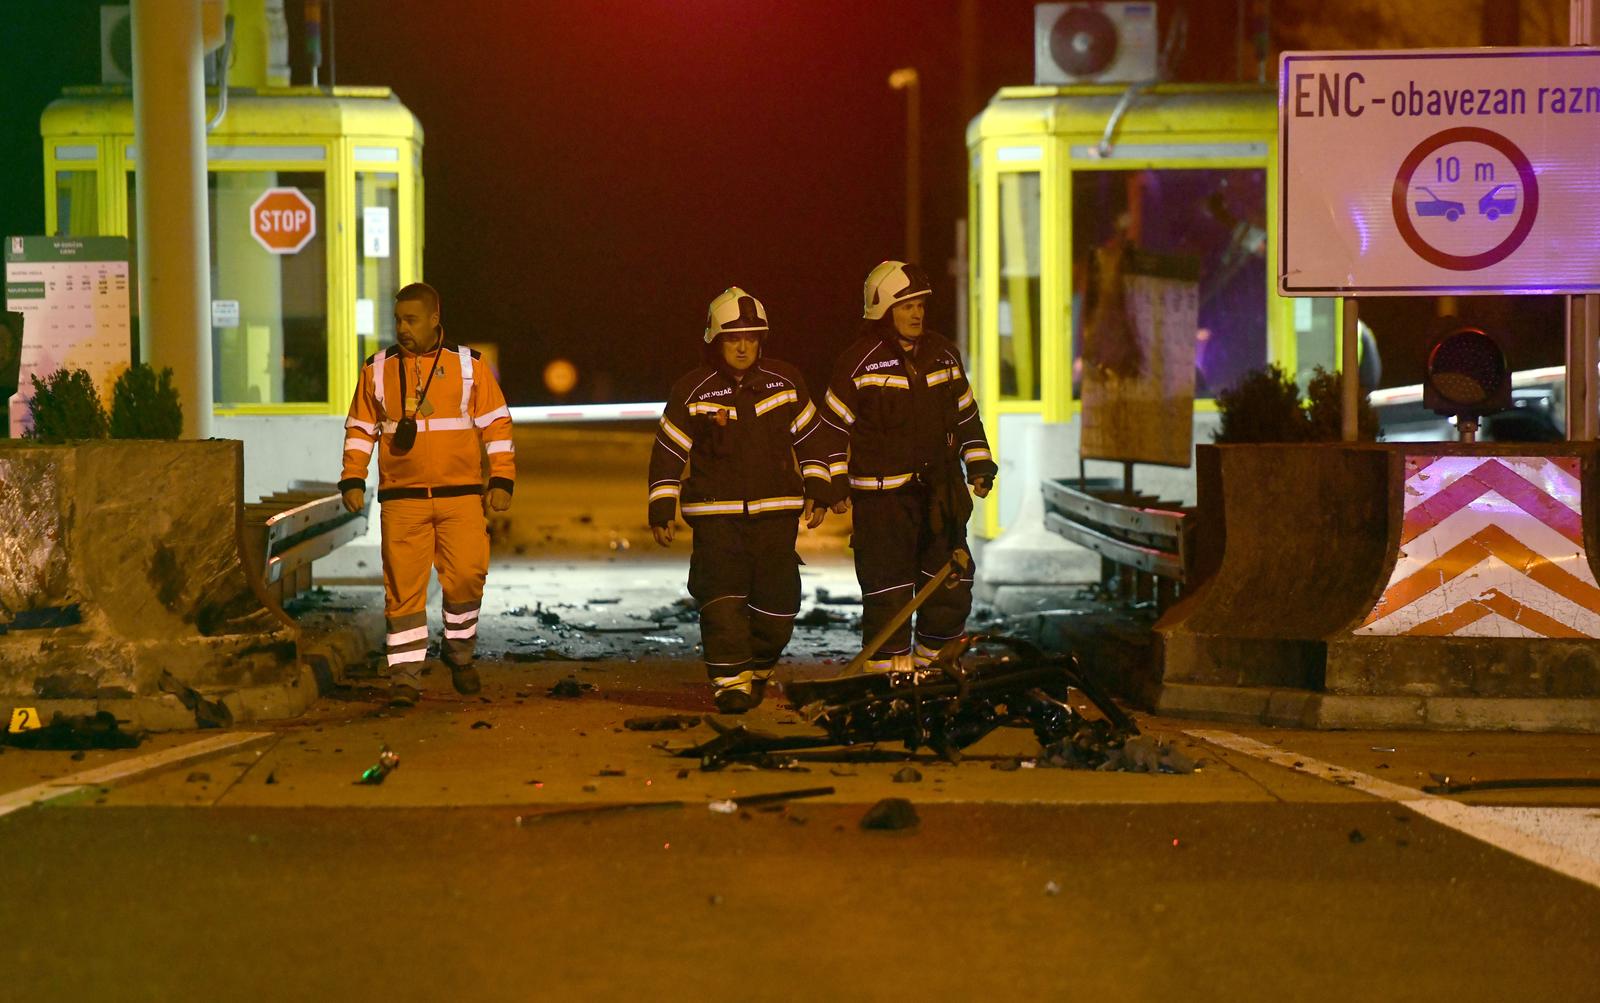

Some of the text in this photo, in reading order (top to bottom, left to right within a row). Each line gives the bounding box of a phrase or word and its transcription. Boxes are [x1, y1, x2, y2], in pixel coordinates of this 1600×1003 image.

[1435, 156, 1495, 183] 10 m
[259, 209, 307, 233] STOP
[18, 710, 30, 730] 2
